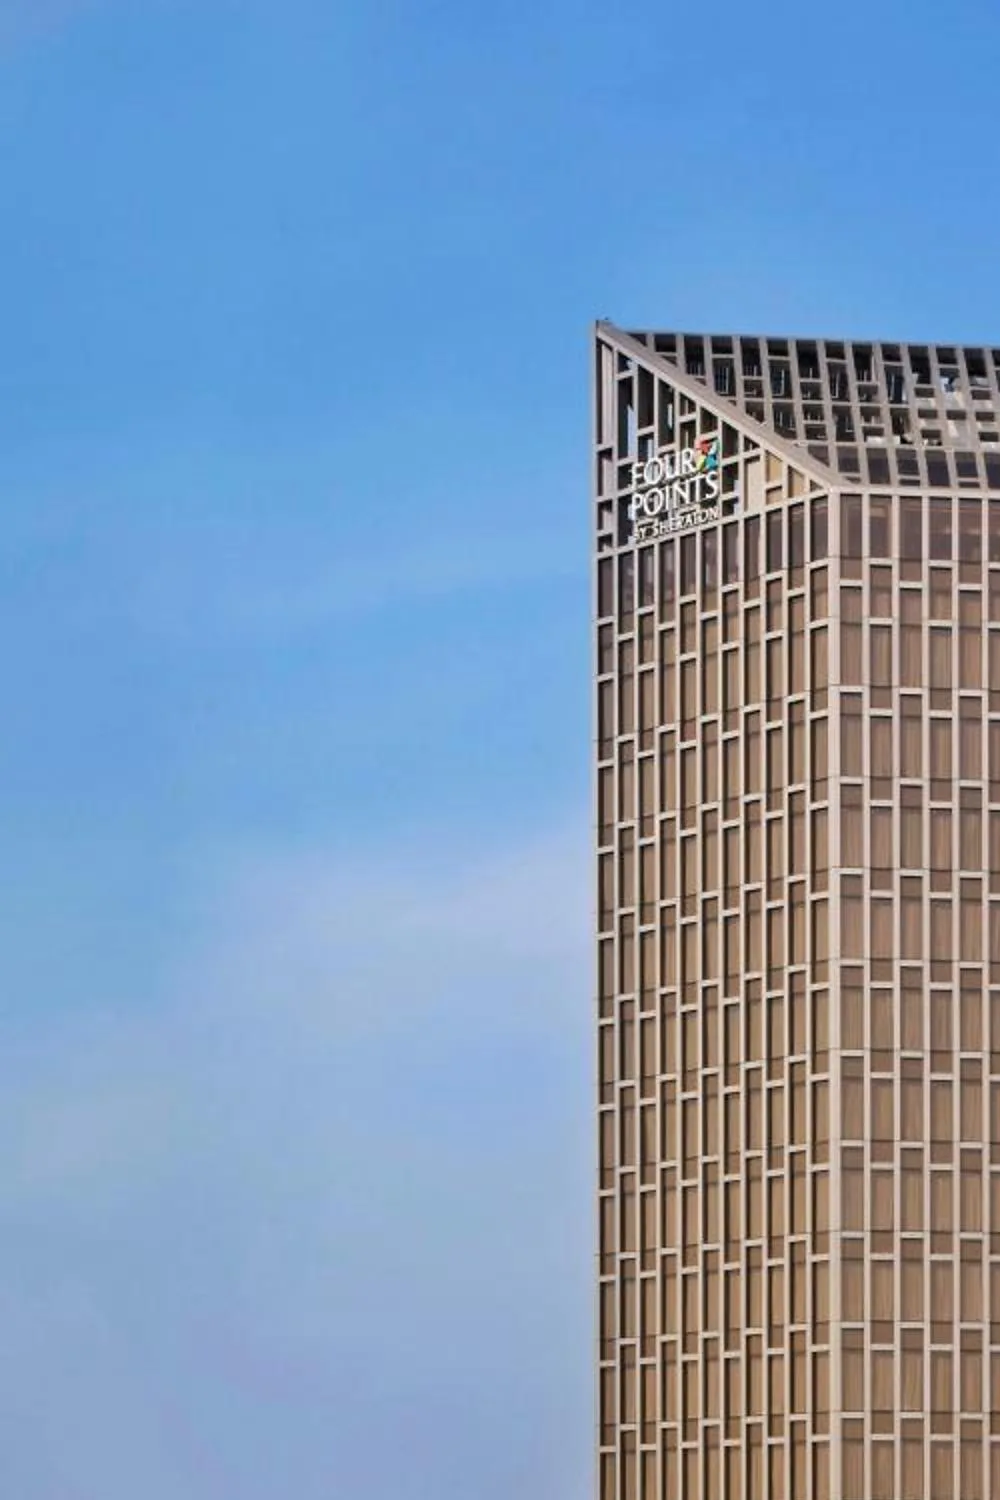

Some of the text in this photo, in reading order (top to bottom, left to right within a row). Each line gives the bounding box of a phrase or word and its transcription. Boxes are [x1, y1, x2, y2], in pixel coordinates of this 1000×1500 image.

[632, 448, 697, 490] FOUR
[632, 471, 719, 519] POINTS
[652, 508, 719, 535] SHERATON
